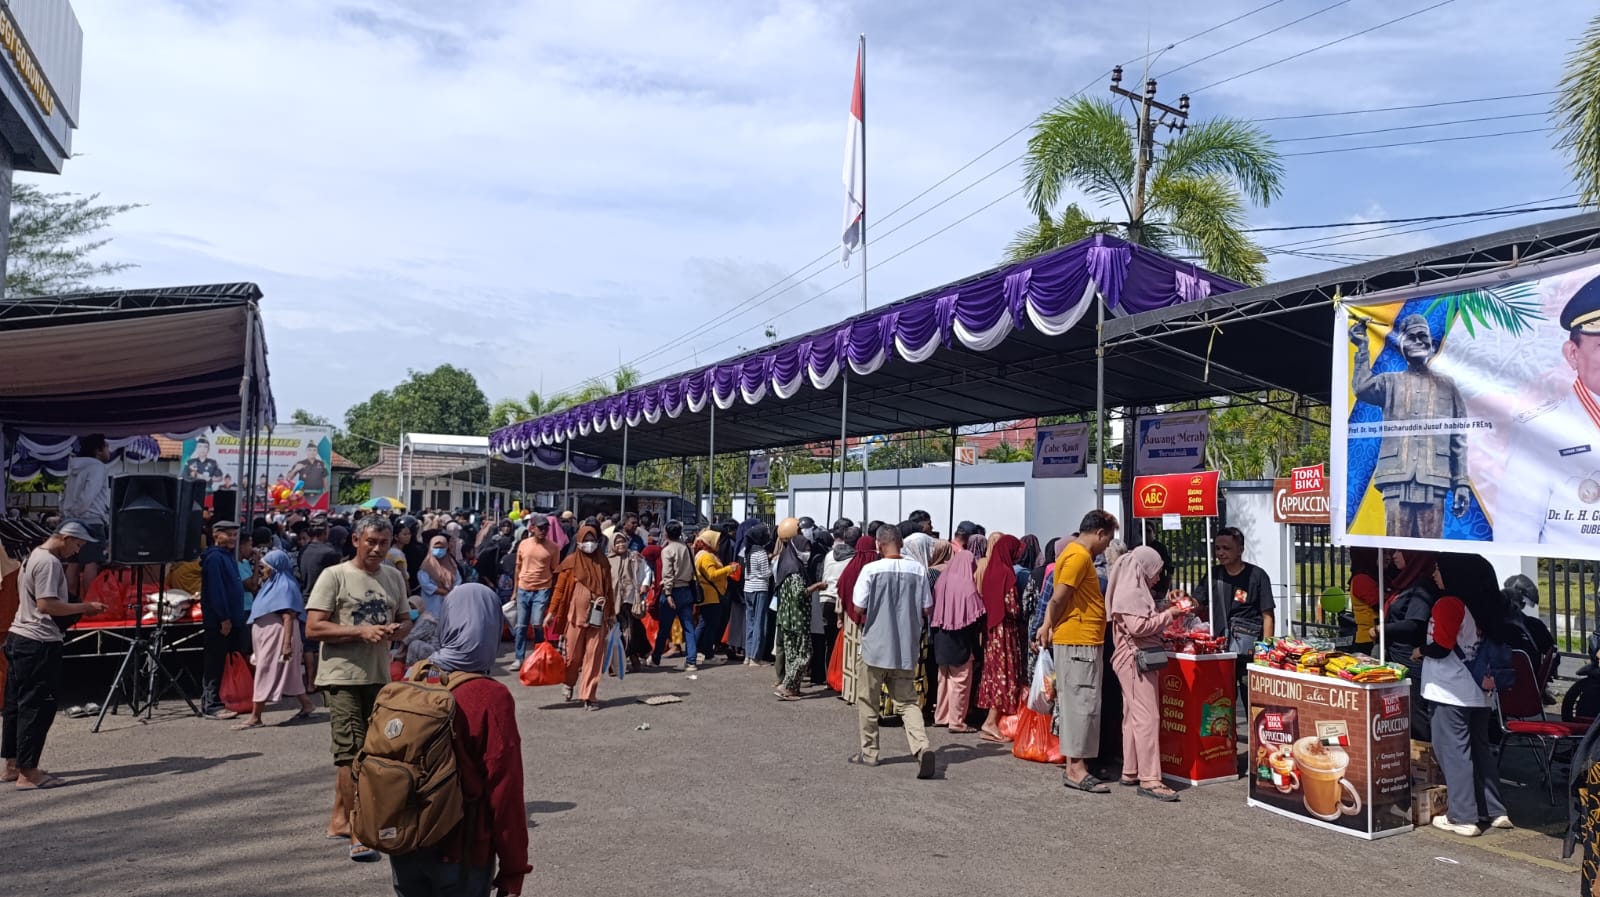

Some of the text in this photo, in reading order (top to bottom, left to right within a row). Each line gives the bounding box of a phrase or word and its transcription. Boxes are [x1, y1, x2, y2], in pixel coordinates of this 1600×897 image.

[15, 40, 55, 116] GORONTALO
[1423, 422, 1442, 431] Jusuf
[1144, 430, 1205, 447] Bawang Merah
[1293, 469, 1321, 480] TORA
[1295, 478, 1321, 490] BIKA
[1145, 492, 1163, 504] ABC
[1277, 488, 1330, 519] CAPPUCCIN
[1547, 509, 1561, 520] Dr.
[1564, 509, 1575, 521] Ir.
[1577, 509, 1589, 521] H.
[1251, 674, 1302, 701] CAPPUCCINO
[1306, 688, 1326, 701] ala
[1329, 688, 1359, 711] CAFE
[1162, 695, 1184, 708] Rasa
[1163, 707, 1184, 720] Soto
[1385, 703, 1400, 714] BIKA
[1161, 719, 1187, 733] Ayam
[1372, 713, 1409, 742] CAPPUCCINO
[1258, 724, 1293, 745] CAPPUCCINO
